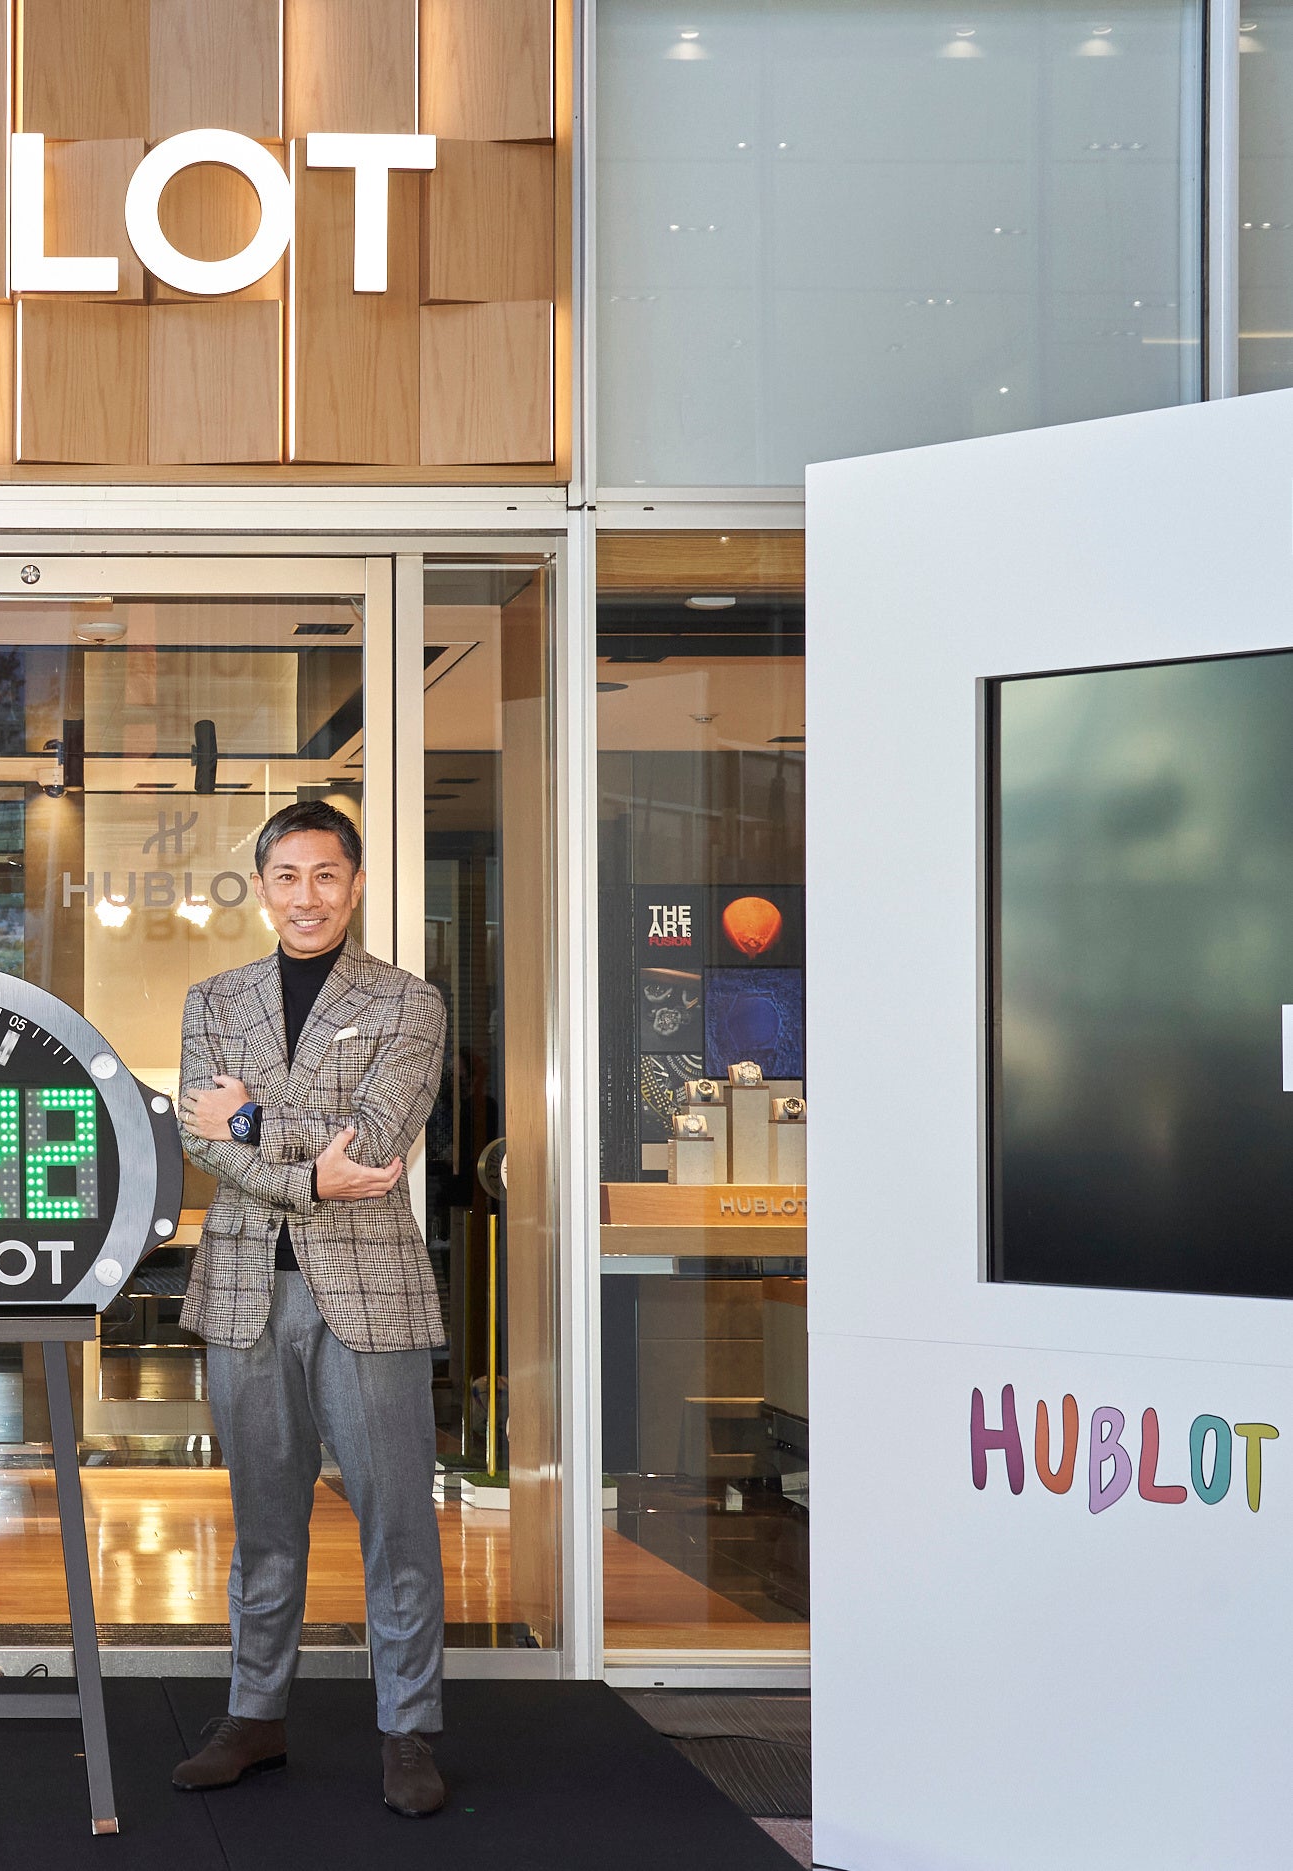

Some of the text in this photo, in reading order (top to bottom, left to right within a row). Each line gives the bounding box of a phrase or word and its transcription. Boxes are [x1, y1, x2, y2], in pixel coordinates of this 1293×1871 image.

[63, 871, 259, 908] HUBLO
[648, 905, 692, 921] THE
[648, 921, 692, 937] ART
[649, 937, 692, 947] FUSION
[8, 1016, 28, 1032] 05
[970, 1383, 1280, 1514] HUBLOT
